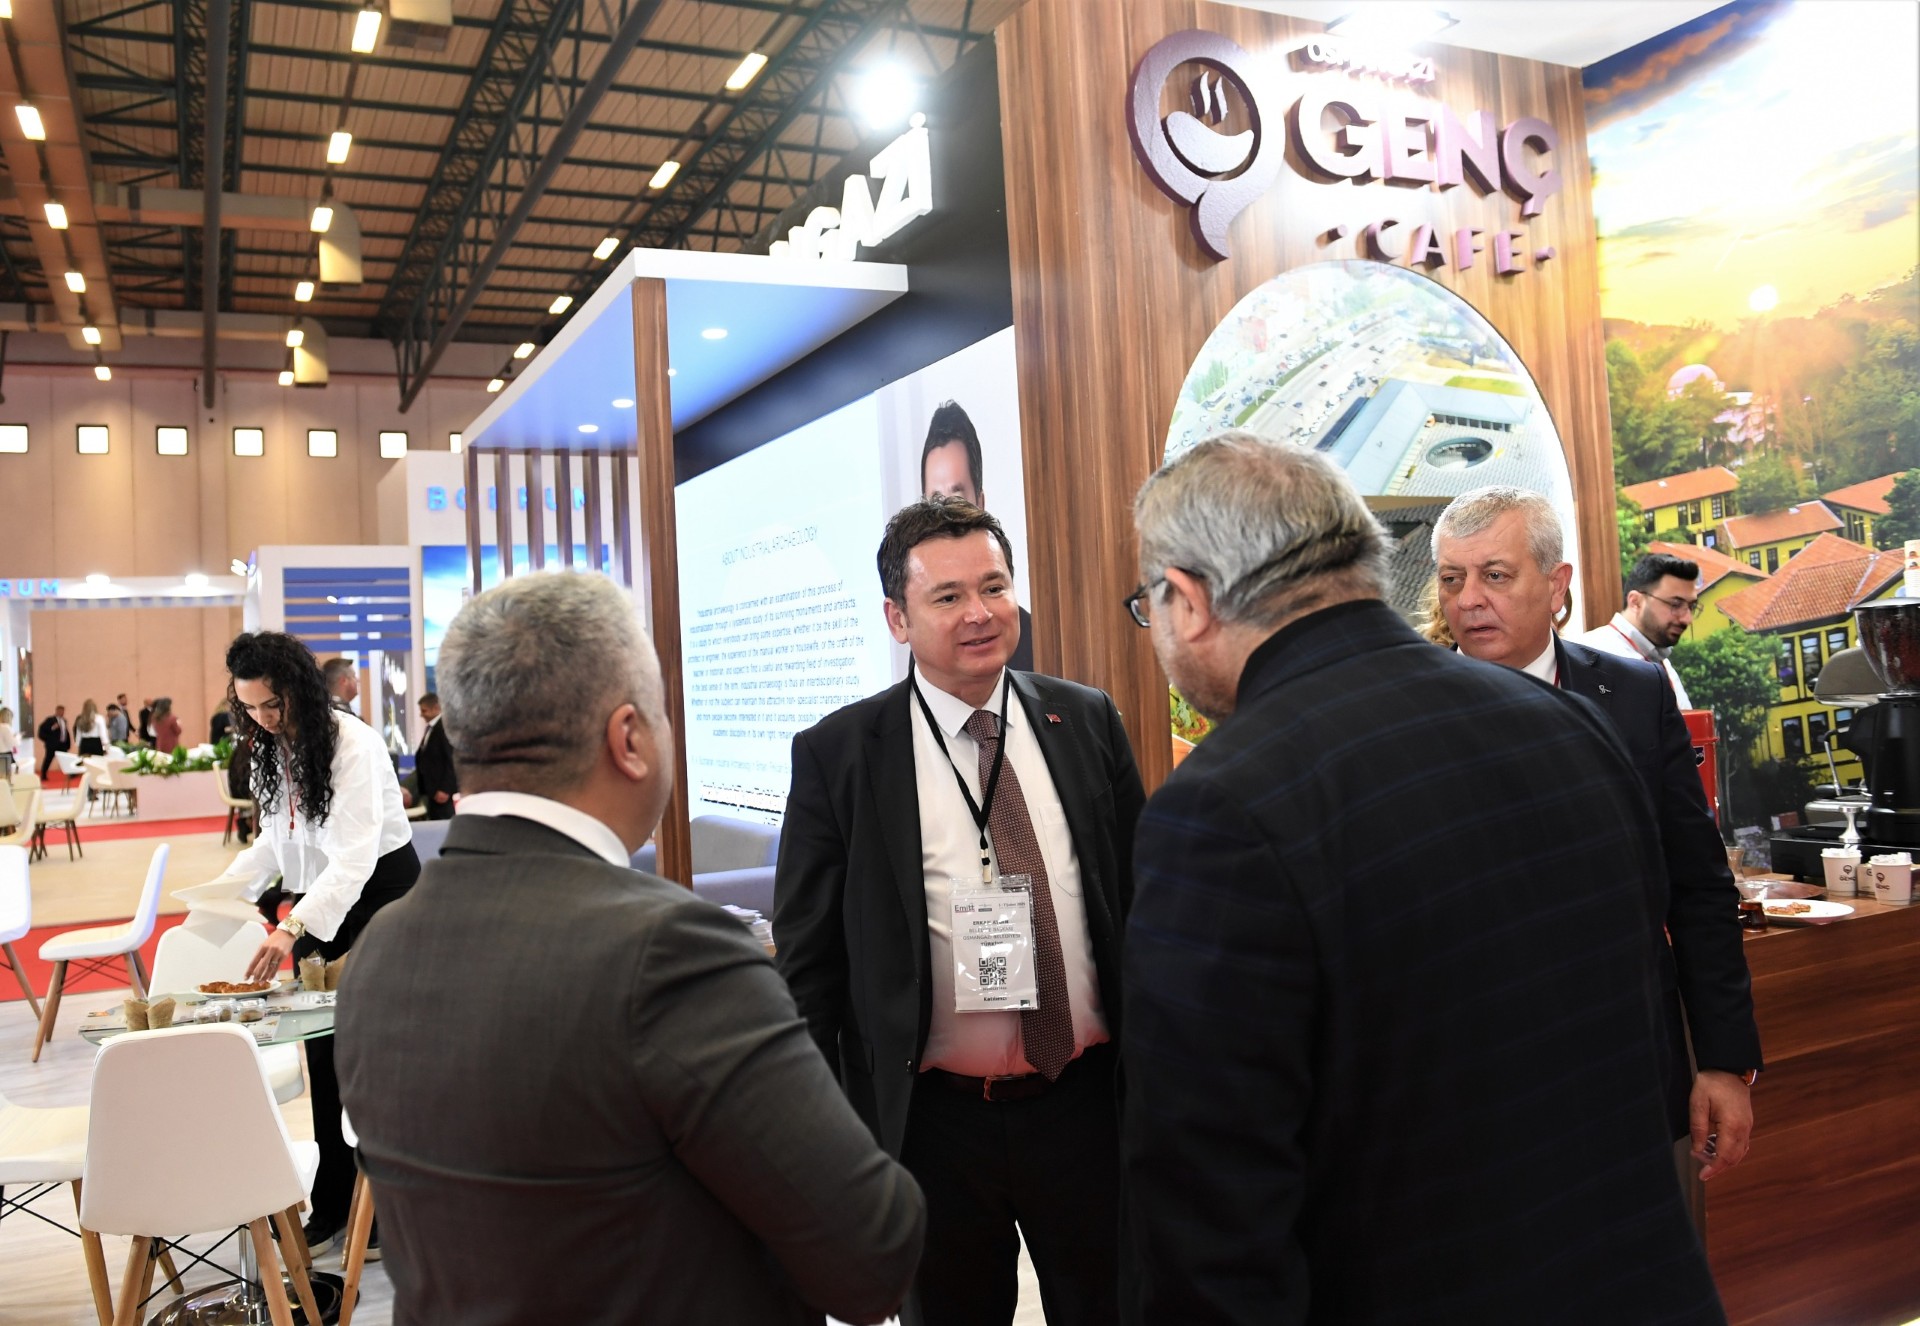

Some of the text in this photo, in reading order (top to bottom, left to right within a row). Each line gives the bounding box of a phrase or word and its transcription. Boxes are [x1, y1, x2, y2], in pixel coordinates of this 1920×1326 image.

[1293, 92, 1562, 216] GENÇ
[1366, 219, 1526, 275] CAFE
[954, 903, 975, 912] Emitt
